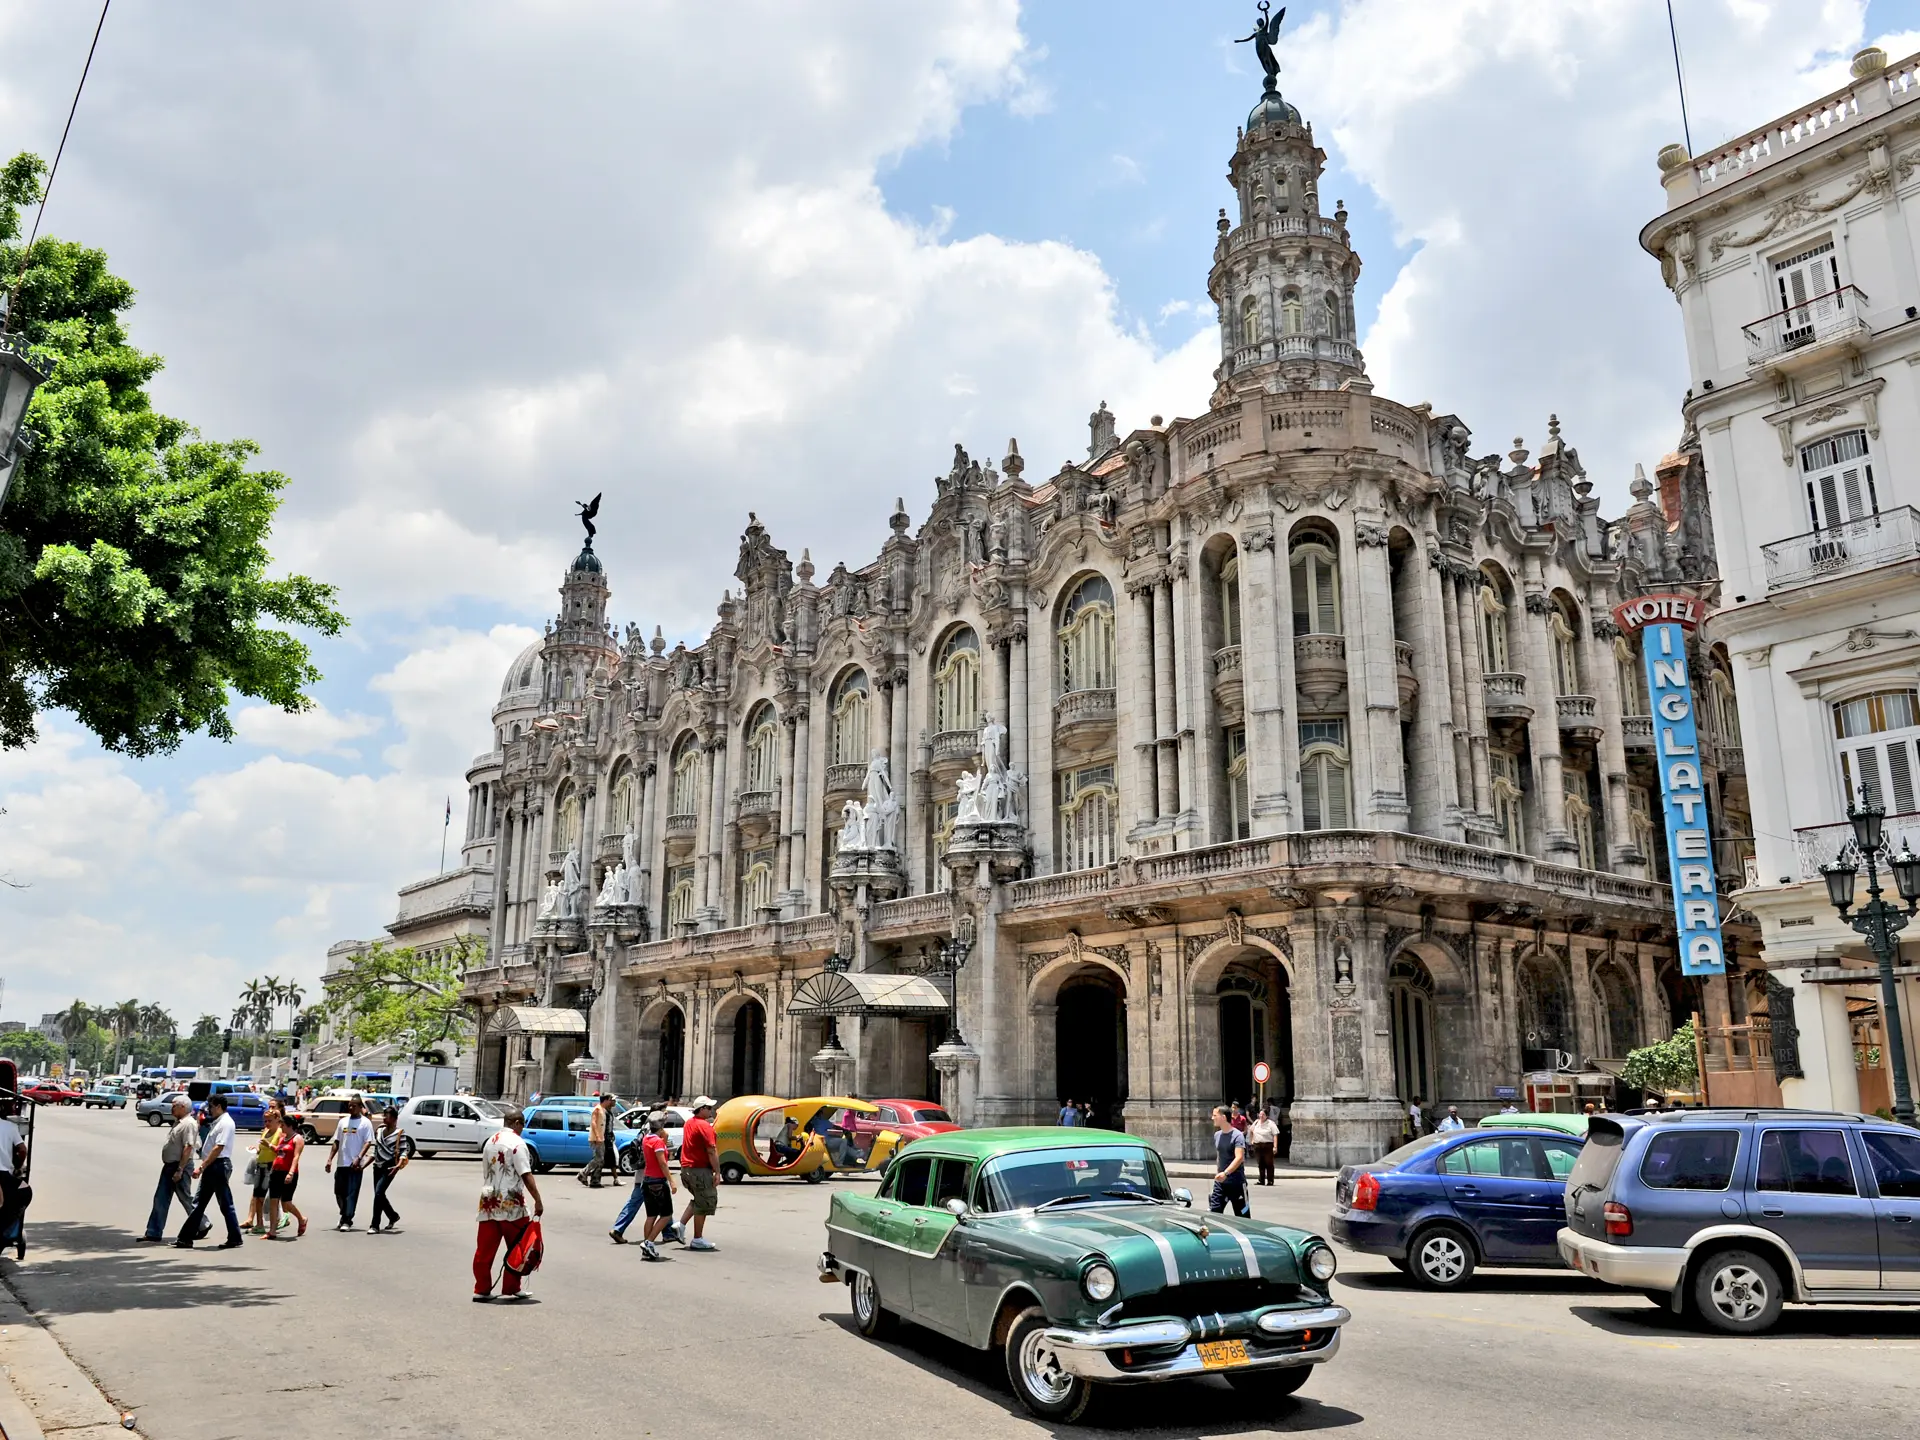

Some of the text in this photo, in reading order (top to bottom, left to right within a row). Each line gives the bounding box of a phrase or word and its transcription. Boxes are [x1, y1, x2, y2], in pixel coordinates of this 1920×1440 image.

[1621, 597, 1697, 628] HOTEL
[1654, 626, 1722, 966] INGLATERRA
[1185, 1266, 1243, 1280] PONTIAC
[1199, 1345, 1246, 1363] HHE785
